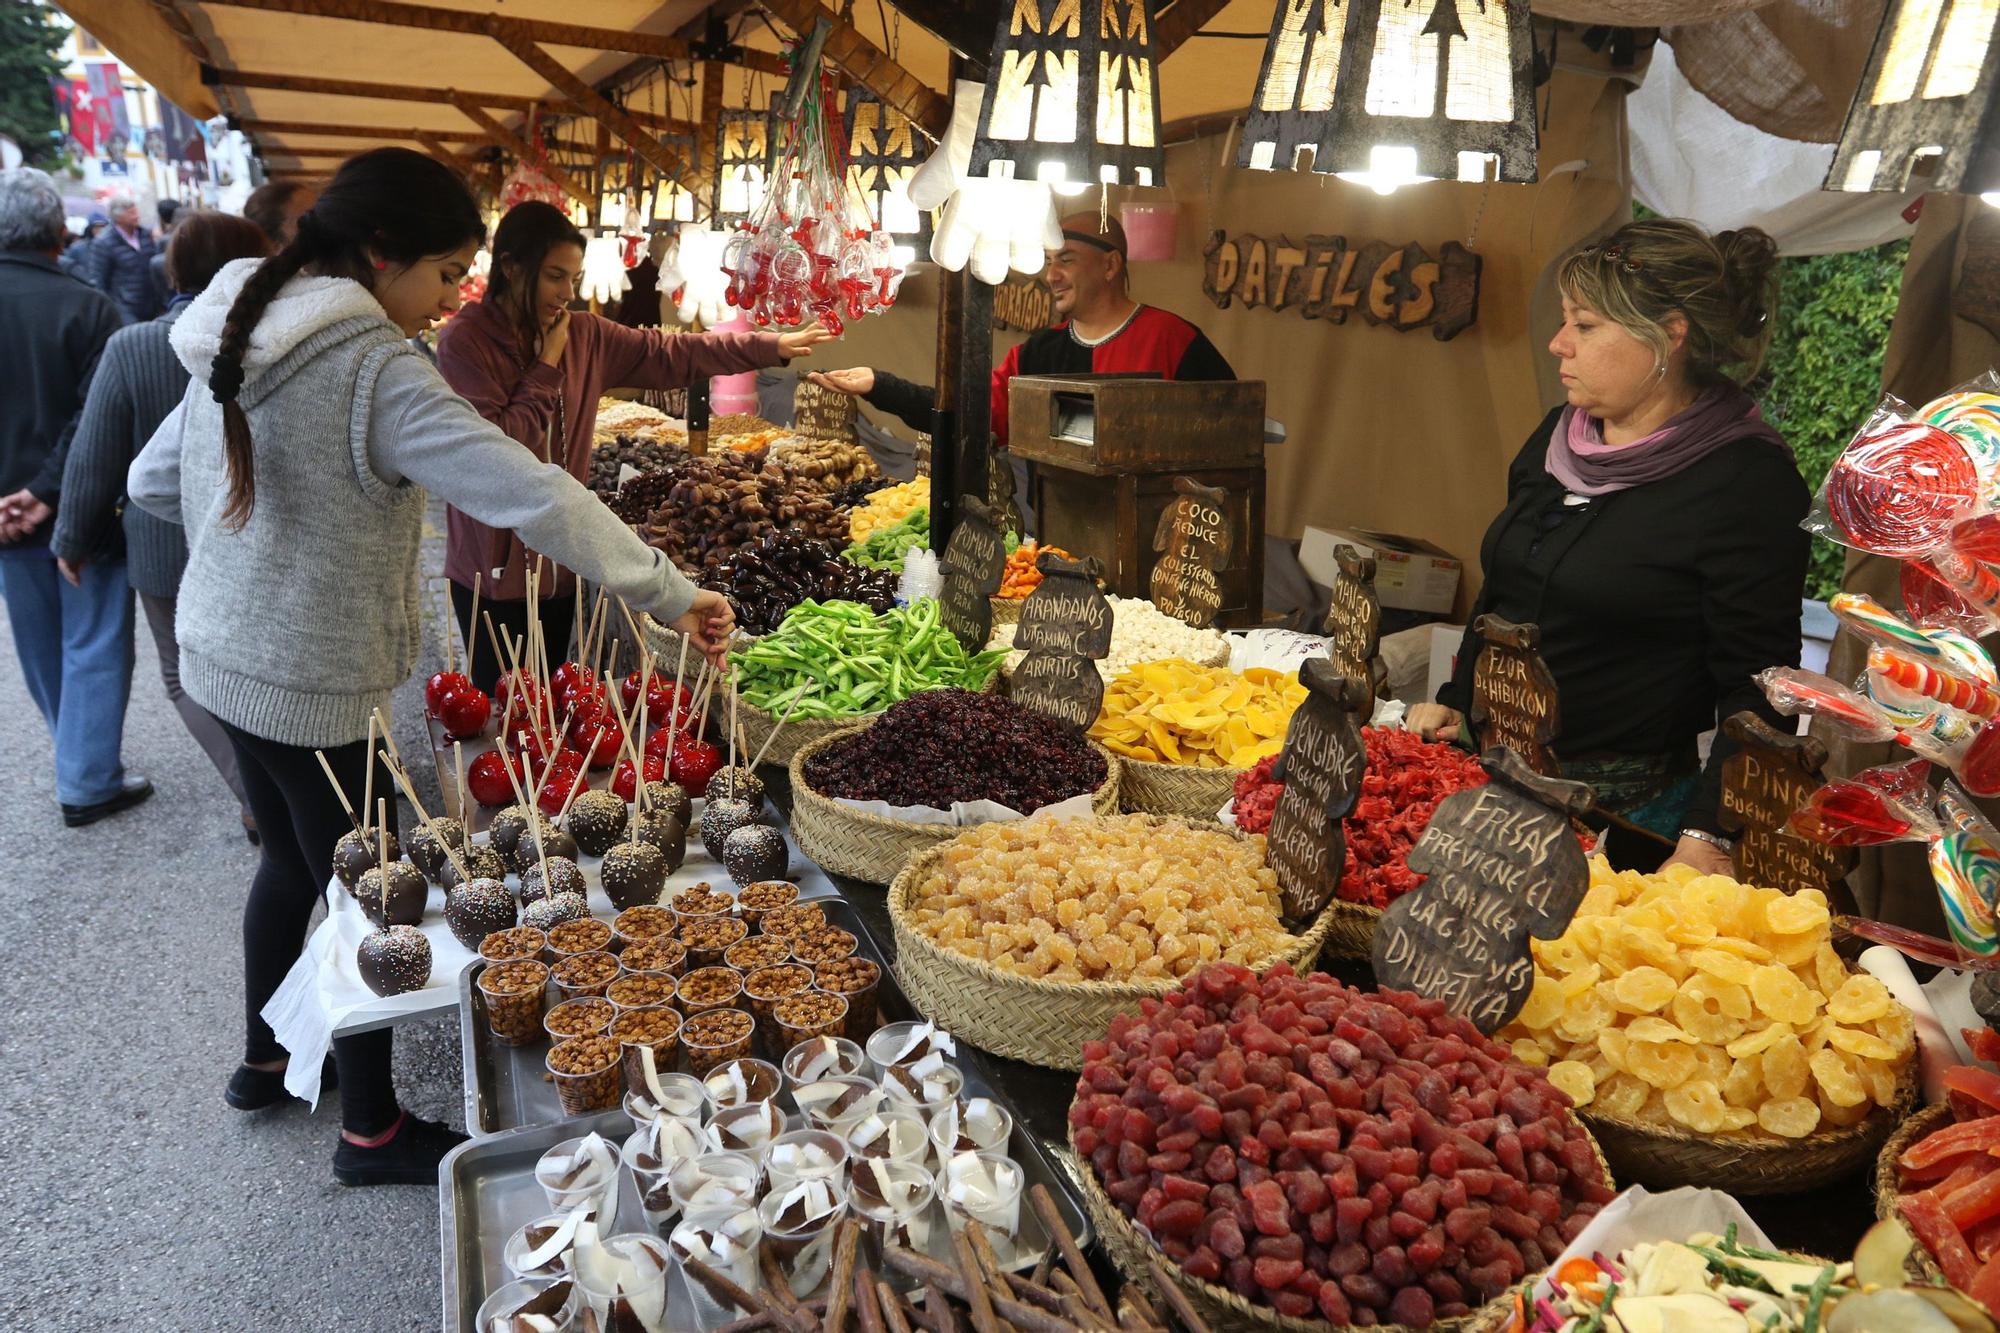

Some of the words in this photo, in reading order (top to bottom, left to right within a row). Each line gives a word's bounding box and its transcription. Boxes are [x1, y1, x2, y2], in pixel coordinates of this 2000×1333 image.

[821, 392, 848, 409] HIGOS
[1177, 501, 1220, 526] COCO
[955, 520, 995, 560] POMELO
[1172, 517, 1219, 544] REDUCE
[947, 547, 988, 580] DIURETICO
[1180, 544, 1199, 560] EL
[955, 574, 979, 600] IDEAL
[1163, 555, 1217, 589] COLESTEROL
[1023, 592, 1106, 630] ARANDANOS
[1189, 581, 1220, 609] HIERRO
[1336, 578, 1370, 623] MANGO
[1023, 624, 1072, 651] VITAMINA
[1024, 655, 1082, 680] ARTRITIS
[1488, 646, 1527, 681] FLOR
[1048, 680, 1056, 694] Y
[1286, 712, 1358, 791] JENGIBRE
[1496, 729, 1533, 755] REDUCE
[1743, 755, 1809, 810] PIÑA
[1281, 783, 1326, 836] PREVIENE
[1461, 789, 1566, 866] FRESAS
[1750, 831, 1769, 851] LA
[1272, 816, 1326, 875] ULCERAS
[1420, 827, 1527, 893] PREVIENE
[1527, 877, 1552, 918] EL
[1409, 894, 1439, 927] LA
